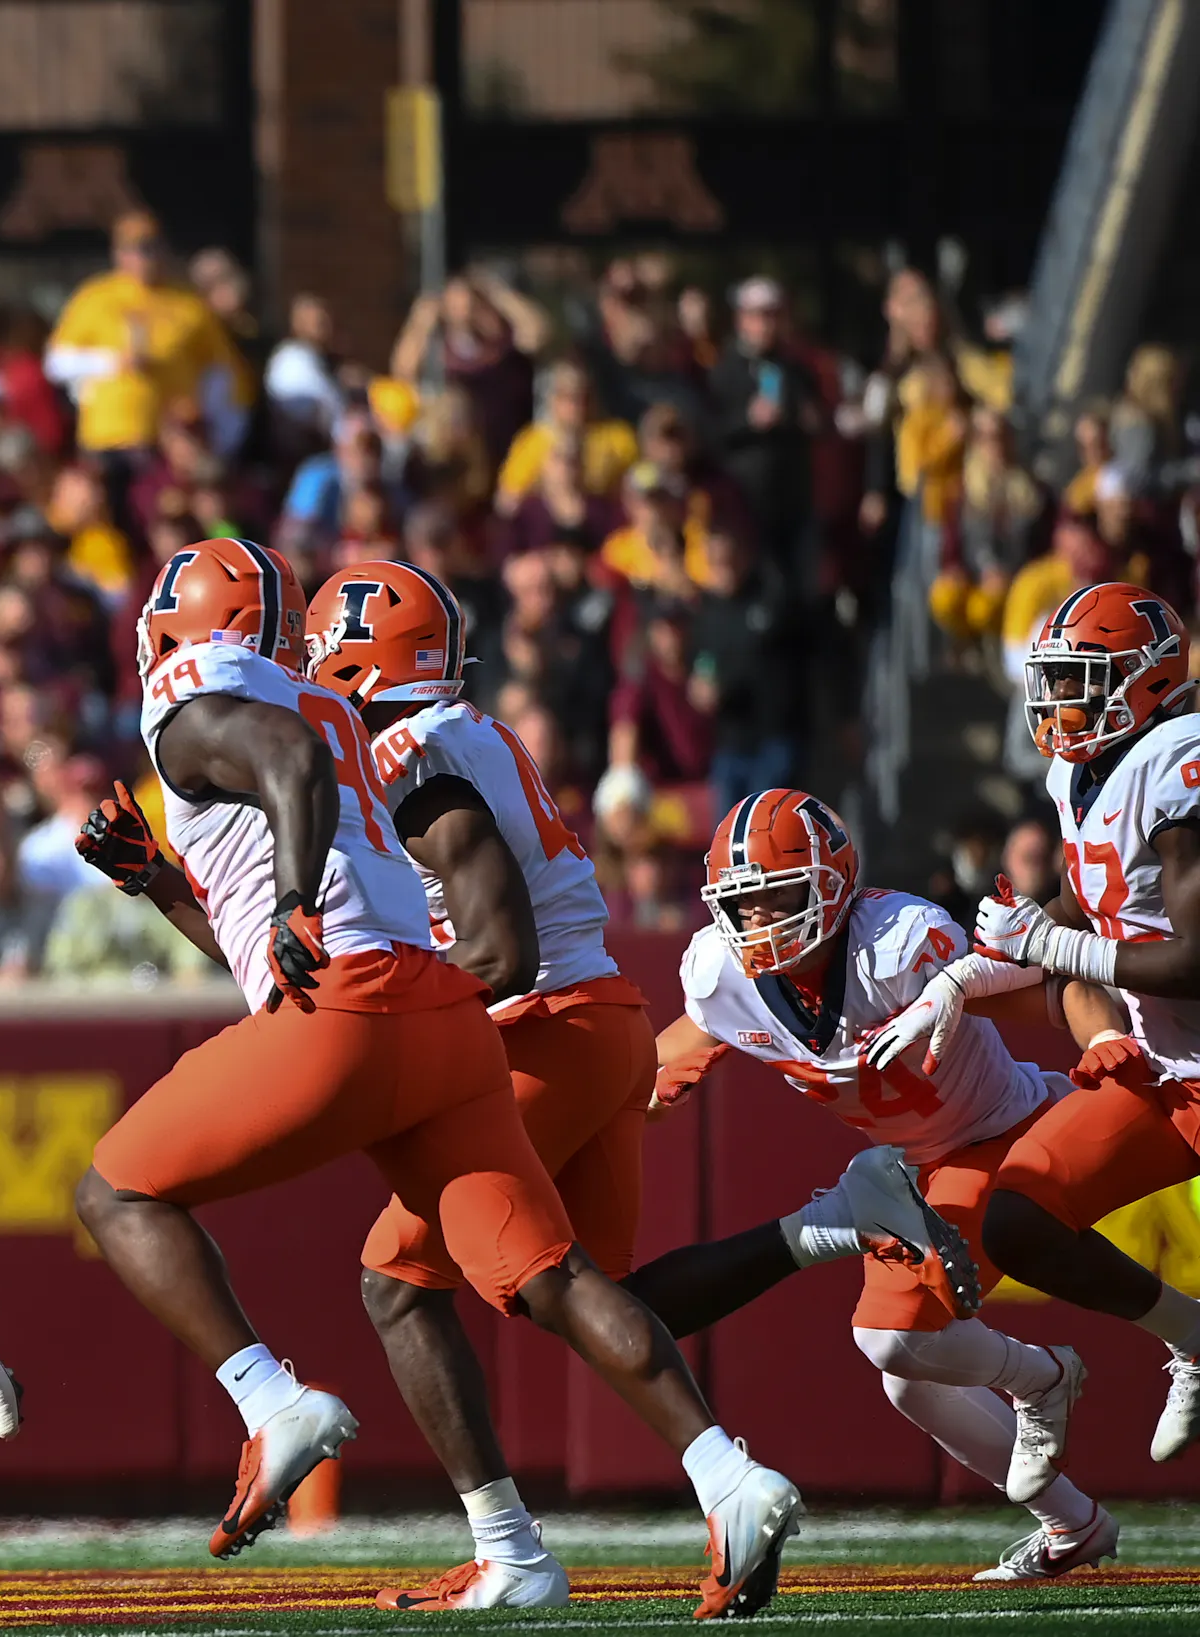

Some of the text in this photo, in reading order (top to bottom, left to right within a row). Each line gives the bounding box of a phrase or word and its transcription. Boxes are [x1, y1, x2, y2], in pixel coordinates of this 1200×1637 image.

[152, 551, 200, 614] I
[333, 581, 384, 642] I
[152, 659, 204, 705] 99
[410, 686, 452, 695] FIGHTING
[375, 728, 426, 785] 49
[912, 927, 956, 974] 74
